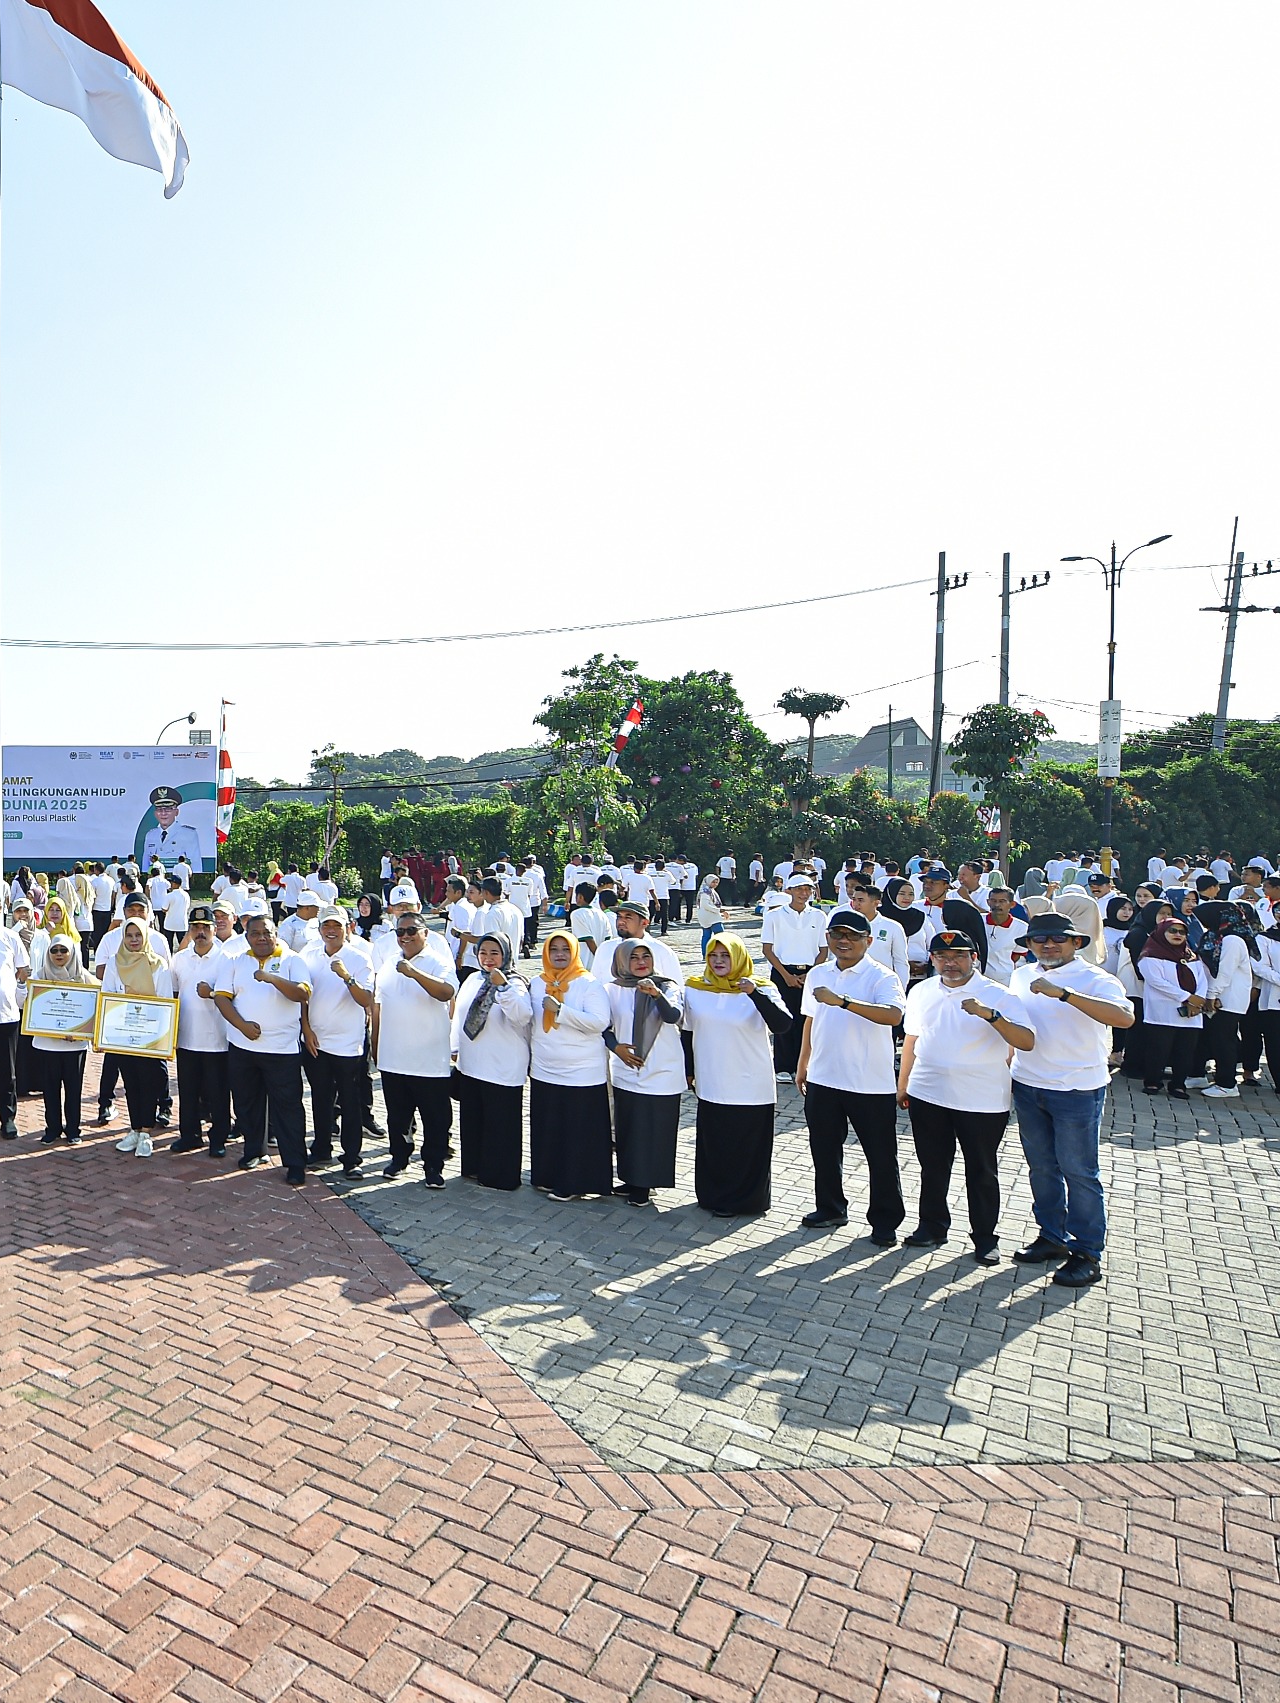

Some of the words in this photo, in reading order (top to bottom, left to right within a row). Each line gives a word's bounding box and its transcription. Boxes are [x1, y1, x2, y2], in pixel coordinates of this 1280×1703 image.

[12, 788, 88, 796] LINGKUNGAN
[91, 788, 126, 796] HIDUP
[2, 799, 48, 810] DUNIA
[50, 799, 87, 810] 2025
[22, 814, 48, 822] Polusi
[49, 814, 77, 822] Plastik
